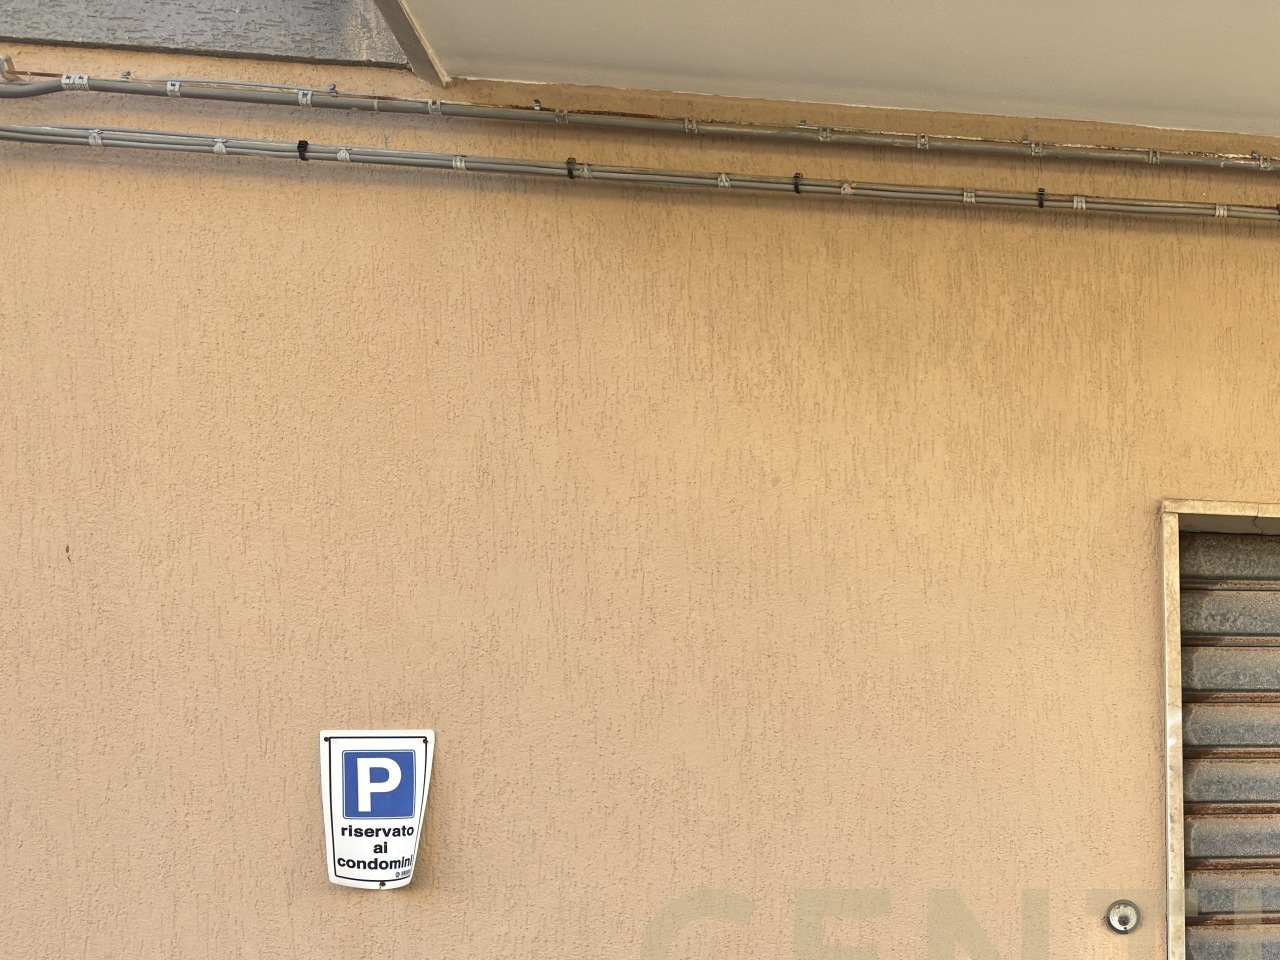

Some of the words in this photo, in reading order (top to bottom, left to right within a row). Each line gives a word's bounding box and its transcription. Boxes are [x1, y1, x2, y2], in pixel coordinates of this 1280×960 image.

[356, 757, 402, 812] P
[341, 824, 415, 838] riservato
[373, 841, 388, 854] ai
[337, 854, 414, 871] condomini
